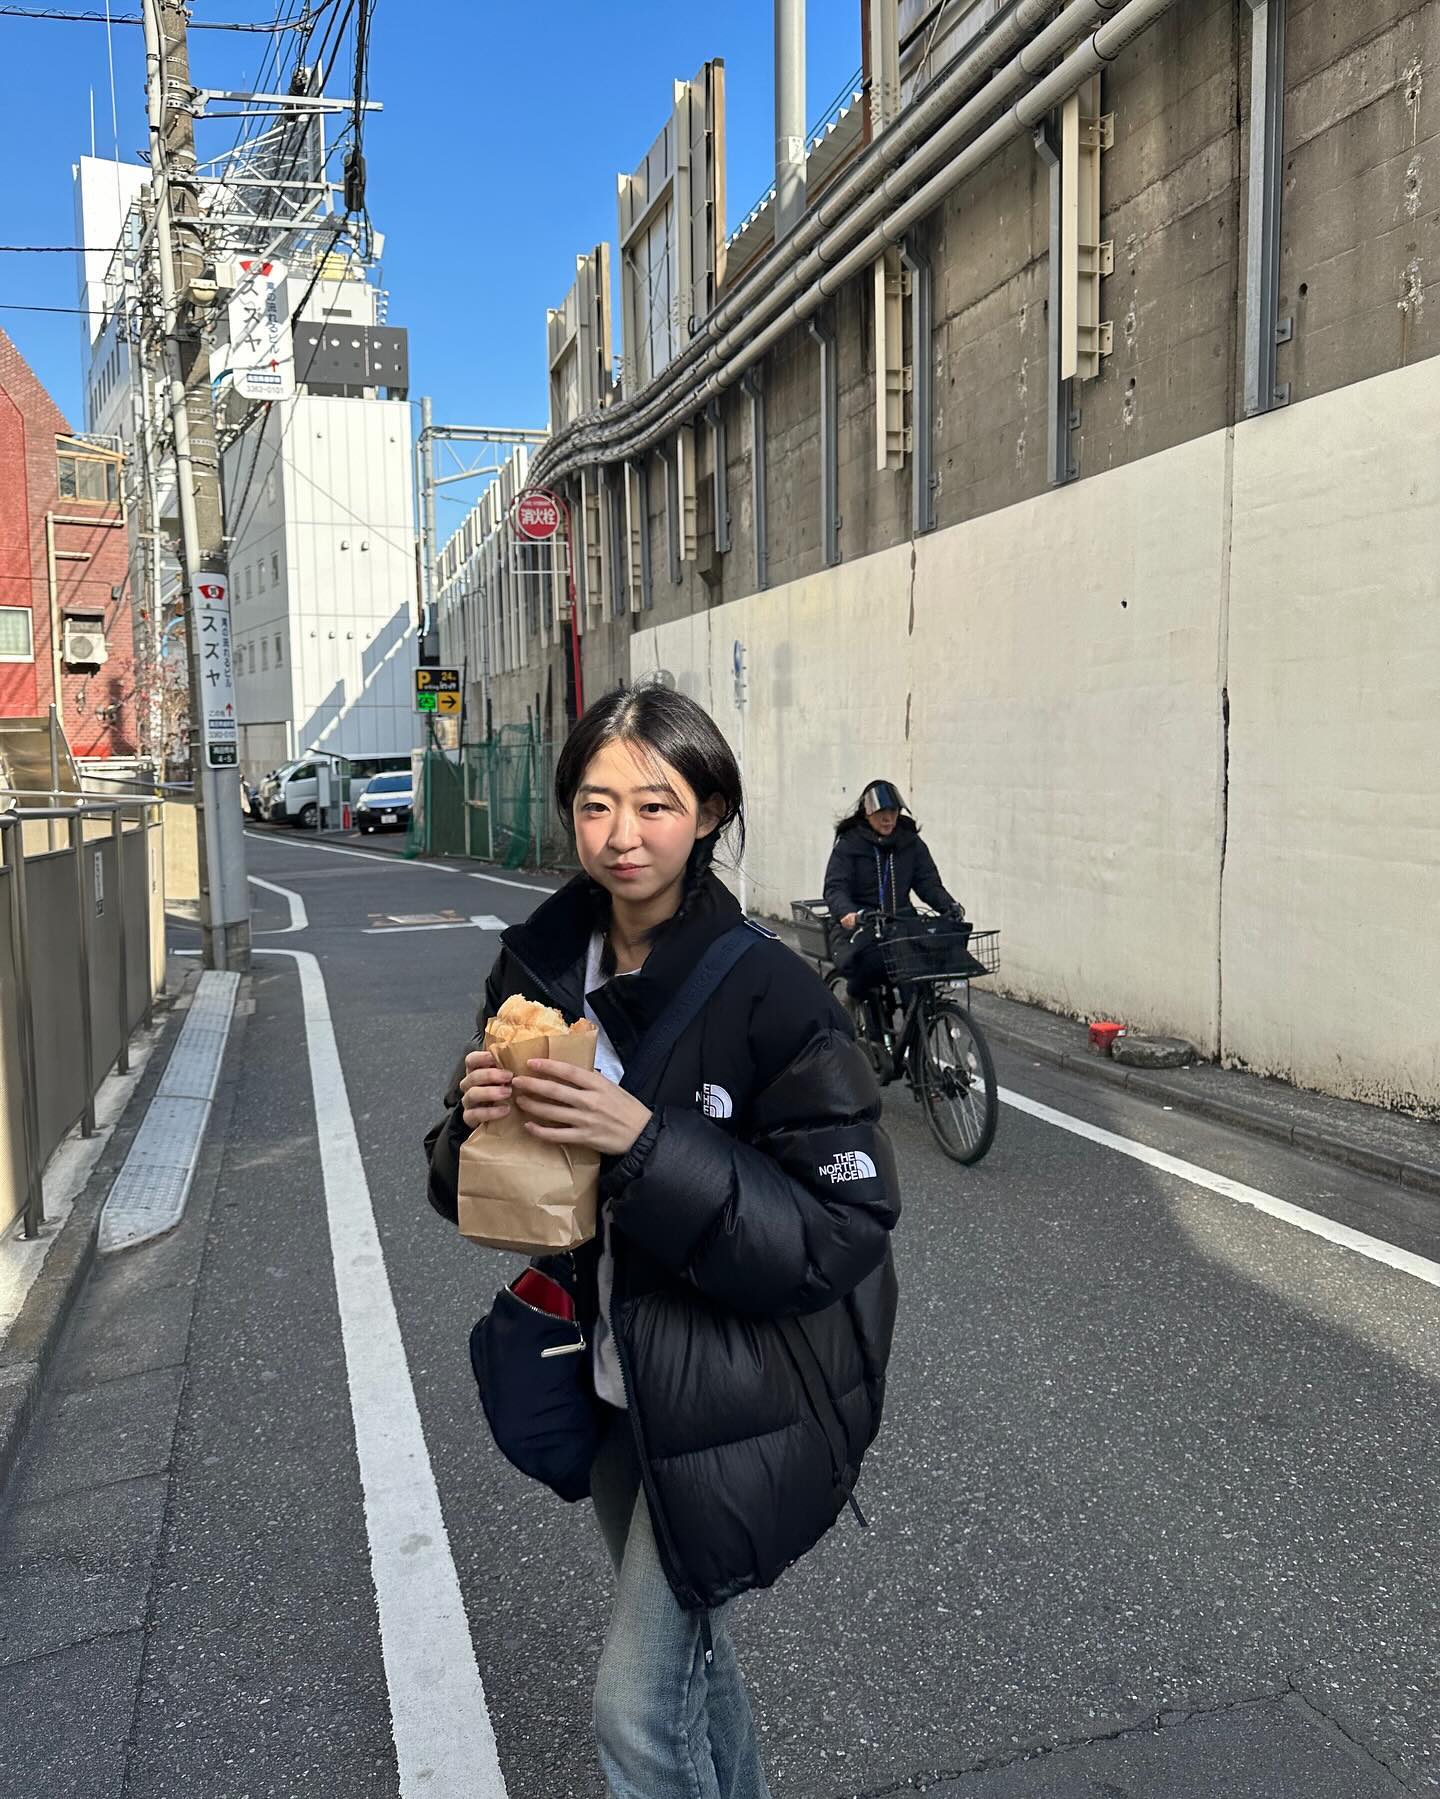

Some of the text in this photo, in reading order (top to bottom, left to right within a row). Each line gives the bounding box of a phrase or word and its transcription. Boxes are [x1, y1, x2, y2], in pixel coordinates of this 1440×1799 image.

[241, 280, 262, 352] スズヤ
[521, 508, 556, 525] 消火栓
[202, 616, 220, 687] スズヤ
[832, 1151, 855, 1163] THE
[818, 1160, 857, 1176] NORTH
[830, 1170, 859, 1183] FACE
